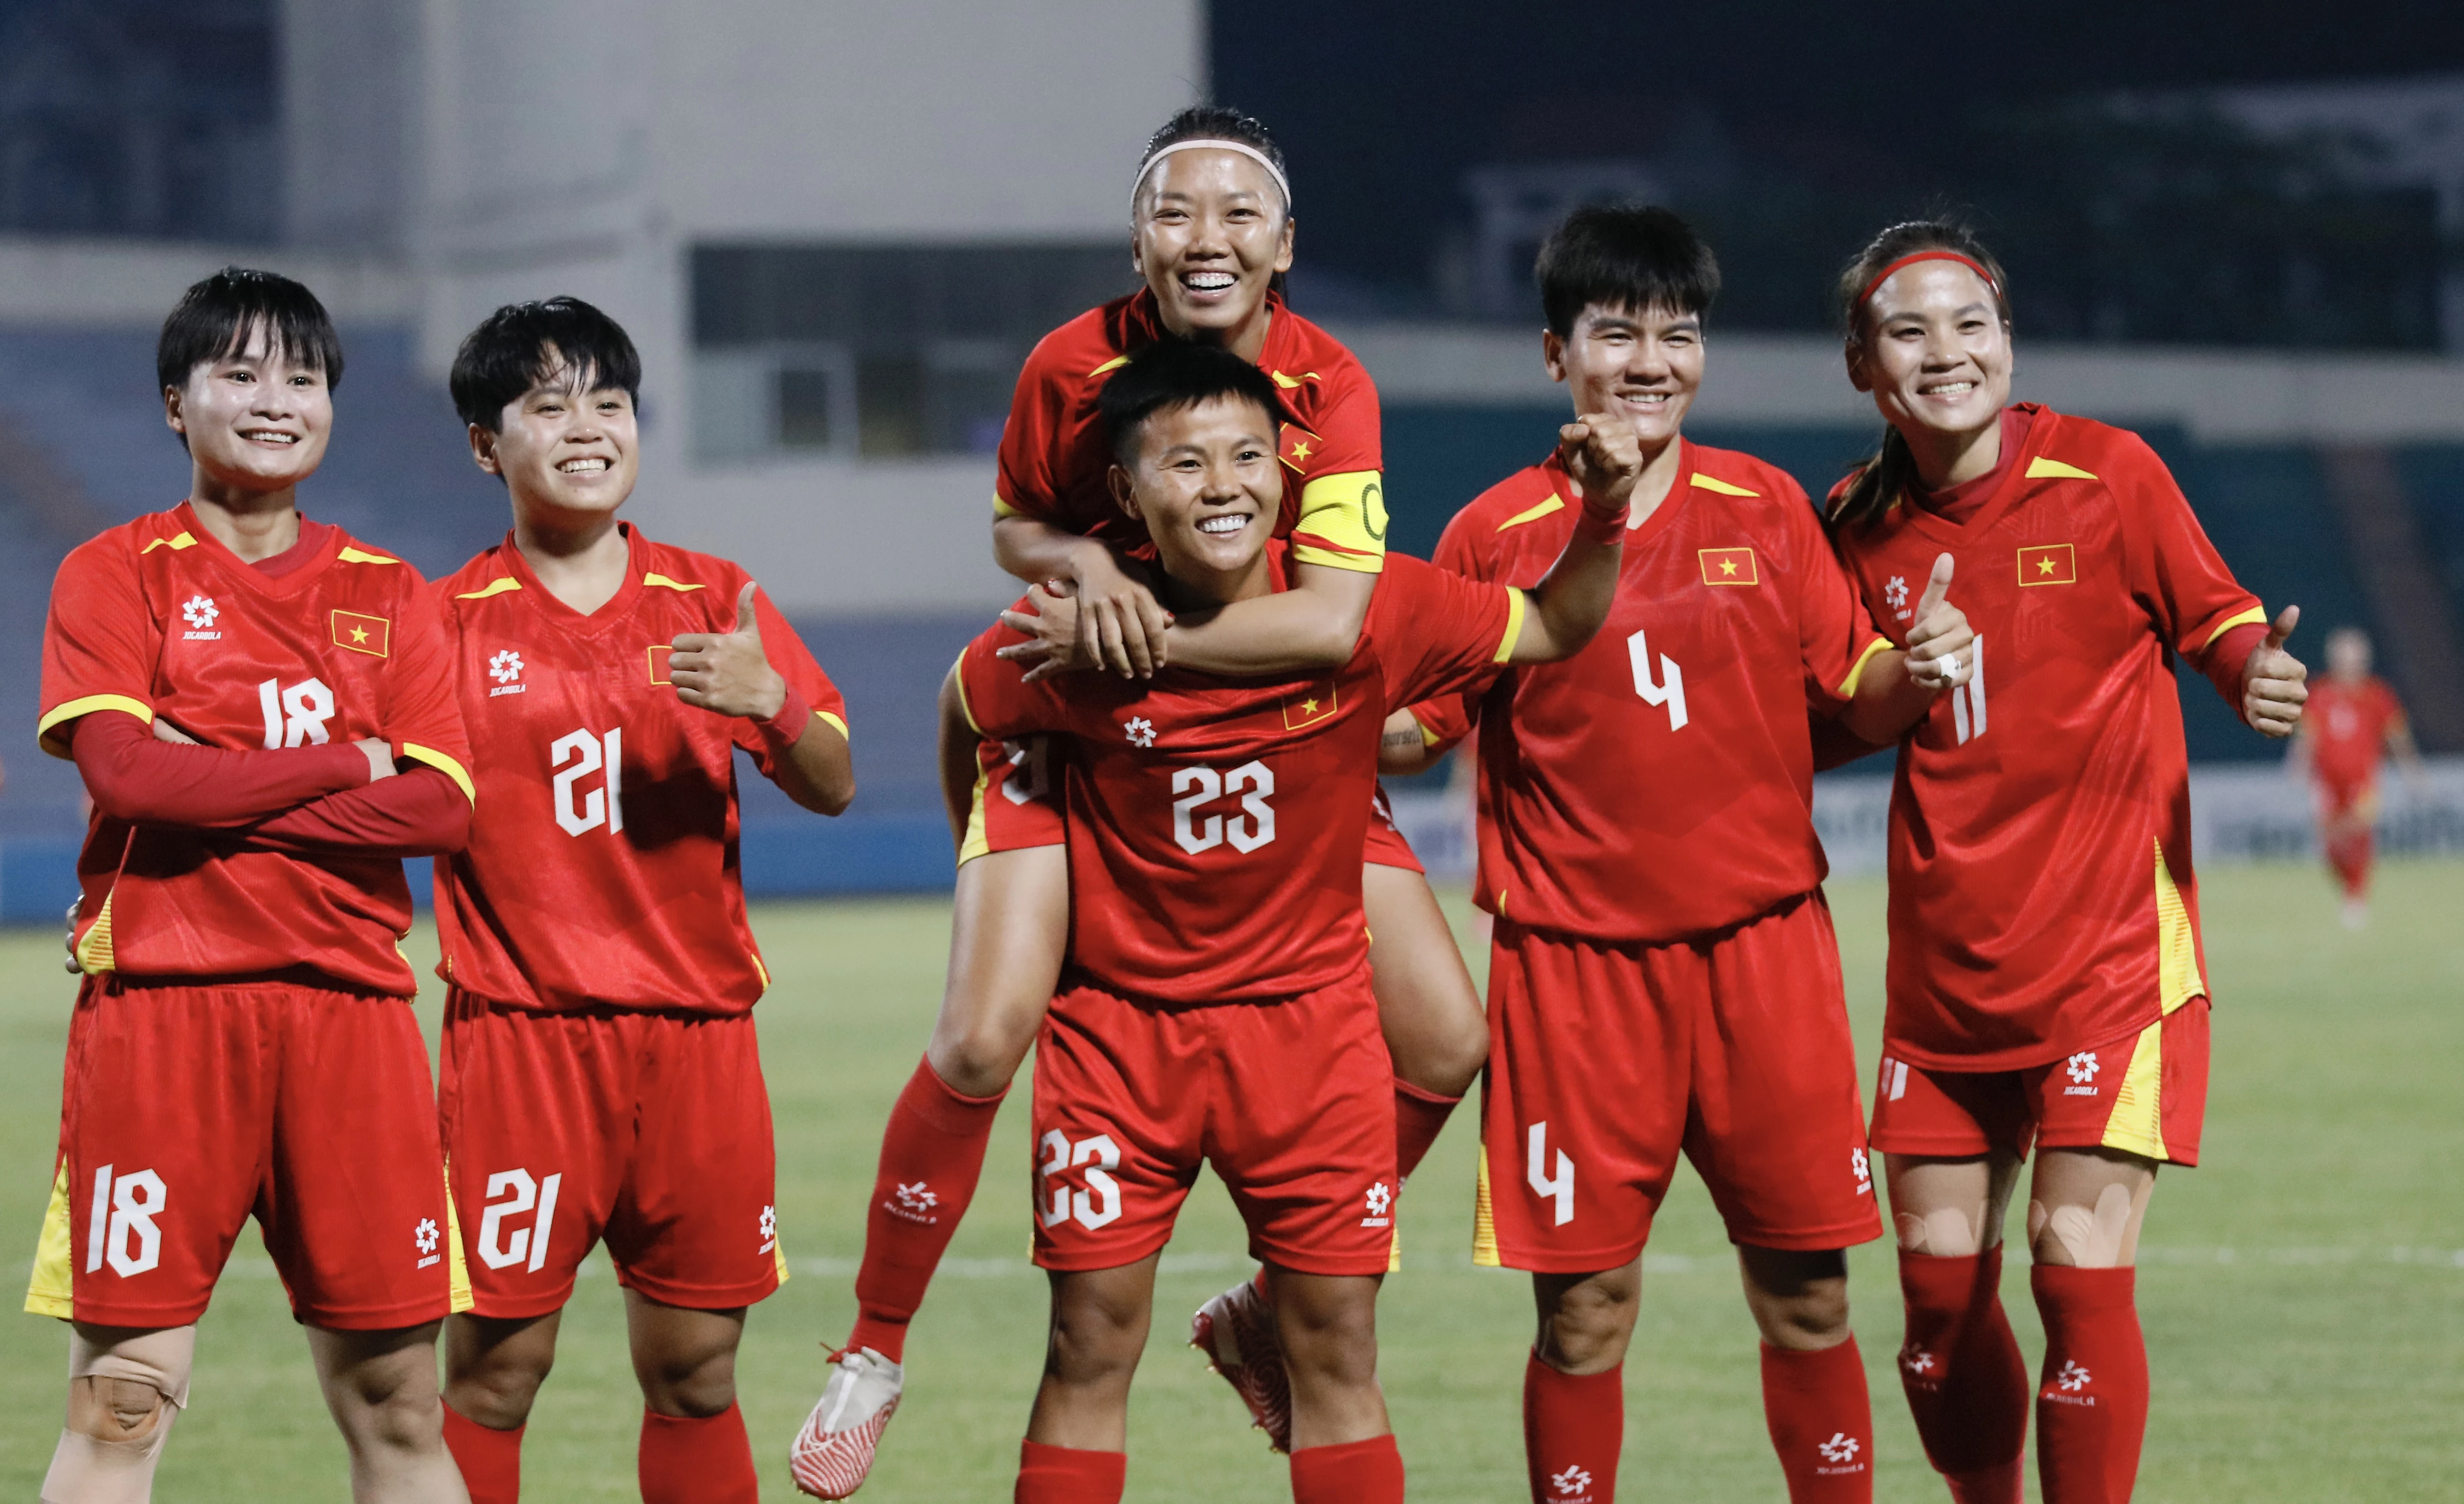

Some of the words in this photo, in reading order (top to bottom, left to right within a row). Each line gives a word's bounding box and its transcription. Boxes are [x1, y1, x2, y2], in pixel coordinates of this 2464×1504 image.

[259, 677, 335, 750] 18
[1627, 629, 1689, 732] 4
[551, 727, 623, 837] 21
[1172, 760, 1276, 855] 23
[86, 1164, 167, 1278] 18
[477, 1168, 562, 1273] 21
[1039, 1128, 1122, 1231] 23
[1527, 1121, 1575, 1226] 4
